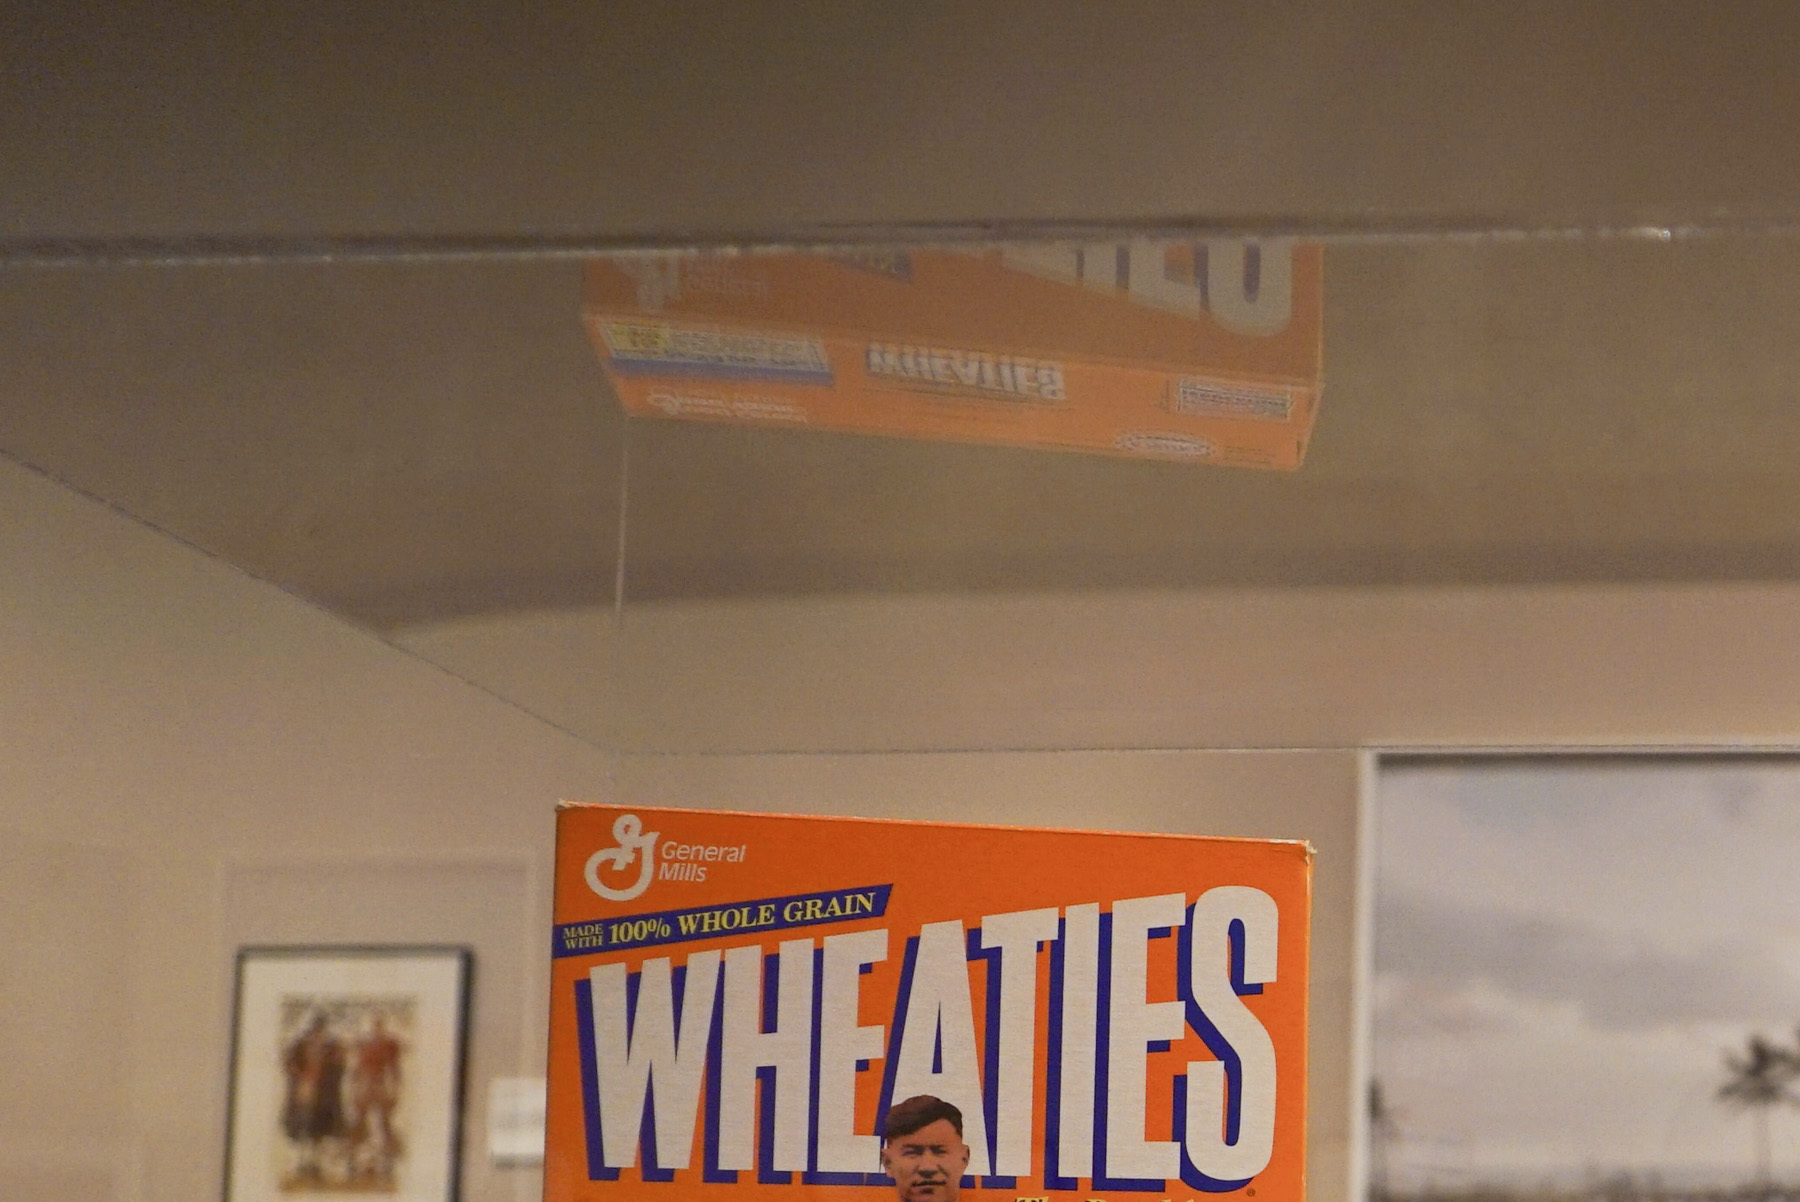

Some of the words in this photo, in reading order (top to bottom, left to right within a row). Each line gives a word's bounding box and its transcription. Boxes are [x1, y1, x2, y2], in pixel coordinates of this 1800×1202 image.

[661, 841, 747, 863] General
[658, 862, 708, 882] Mills
[609, 917, 671, 943] 100%
[677, 904, 776, 935] WHOLE
[783, 892, 877, 922] GRAIN
[563, 924, 603, 939] MADE
[564, 935, 603, 950] WITH
[575, 886, 1279, 1191] WHEATIES
